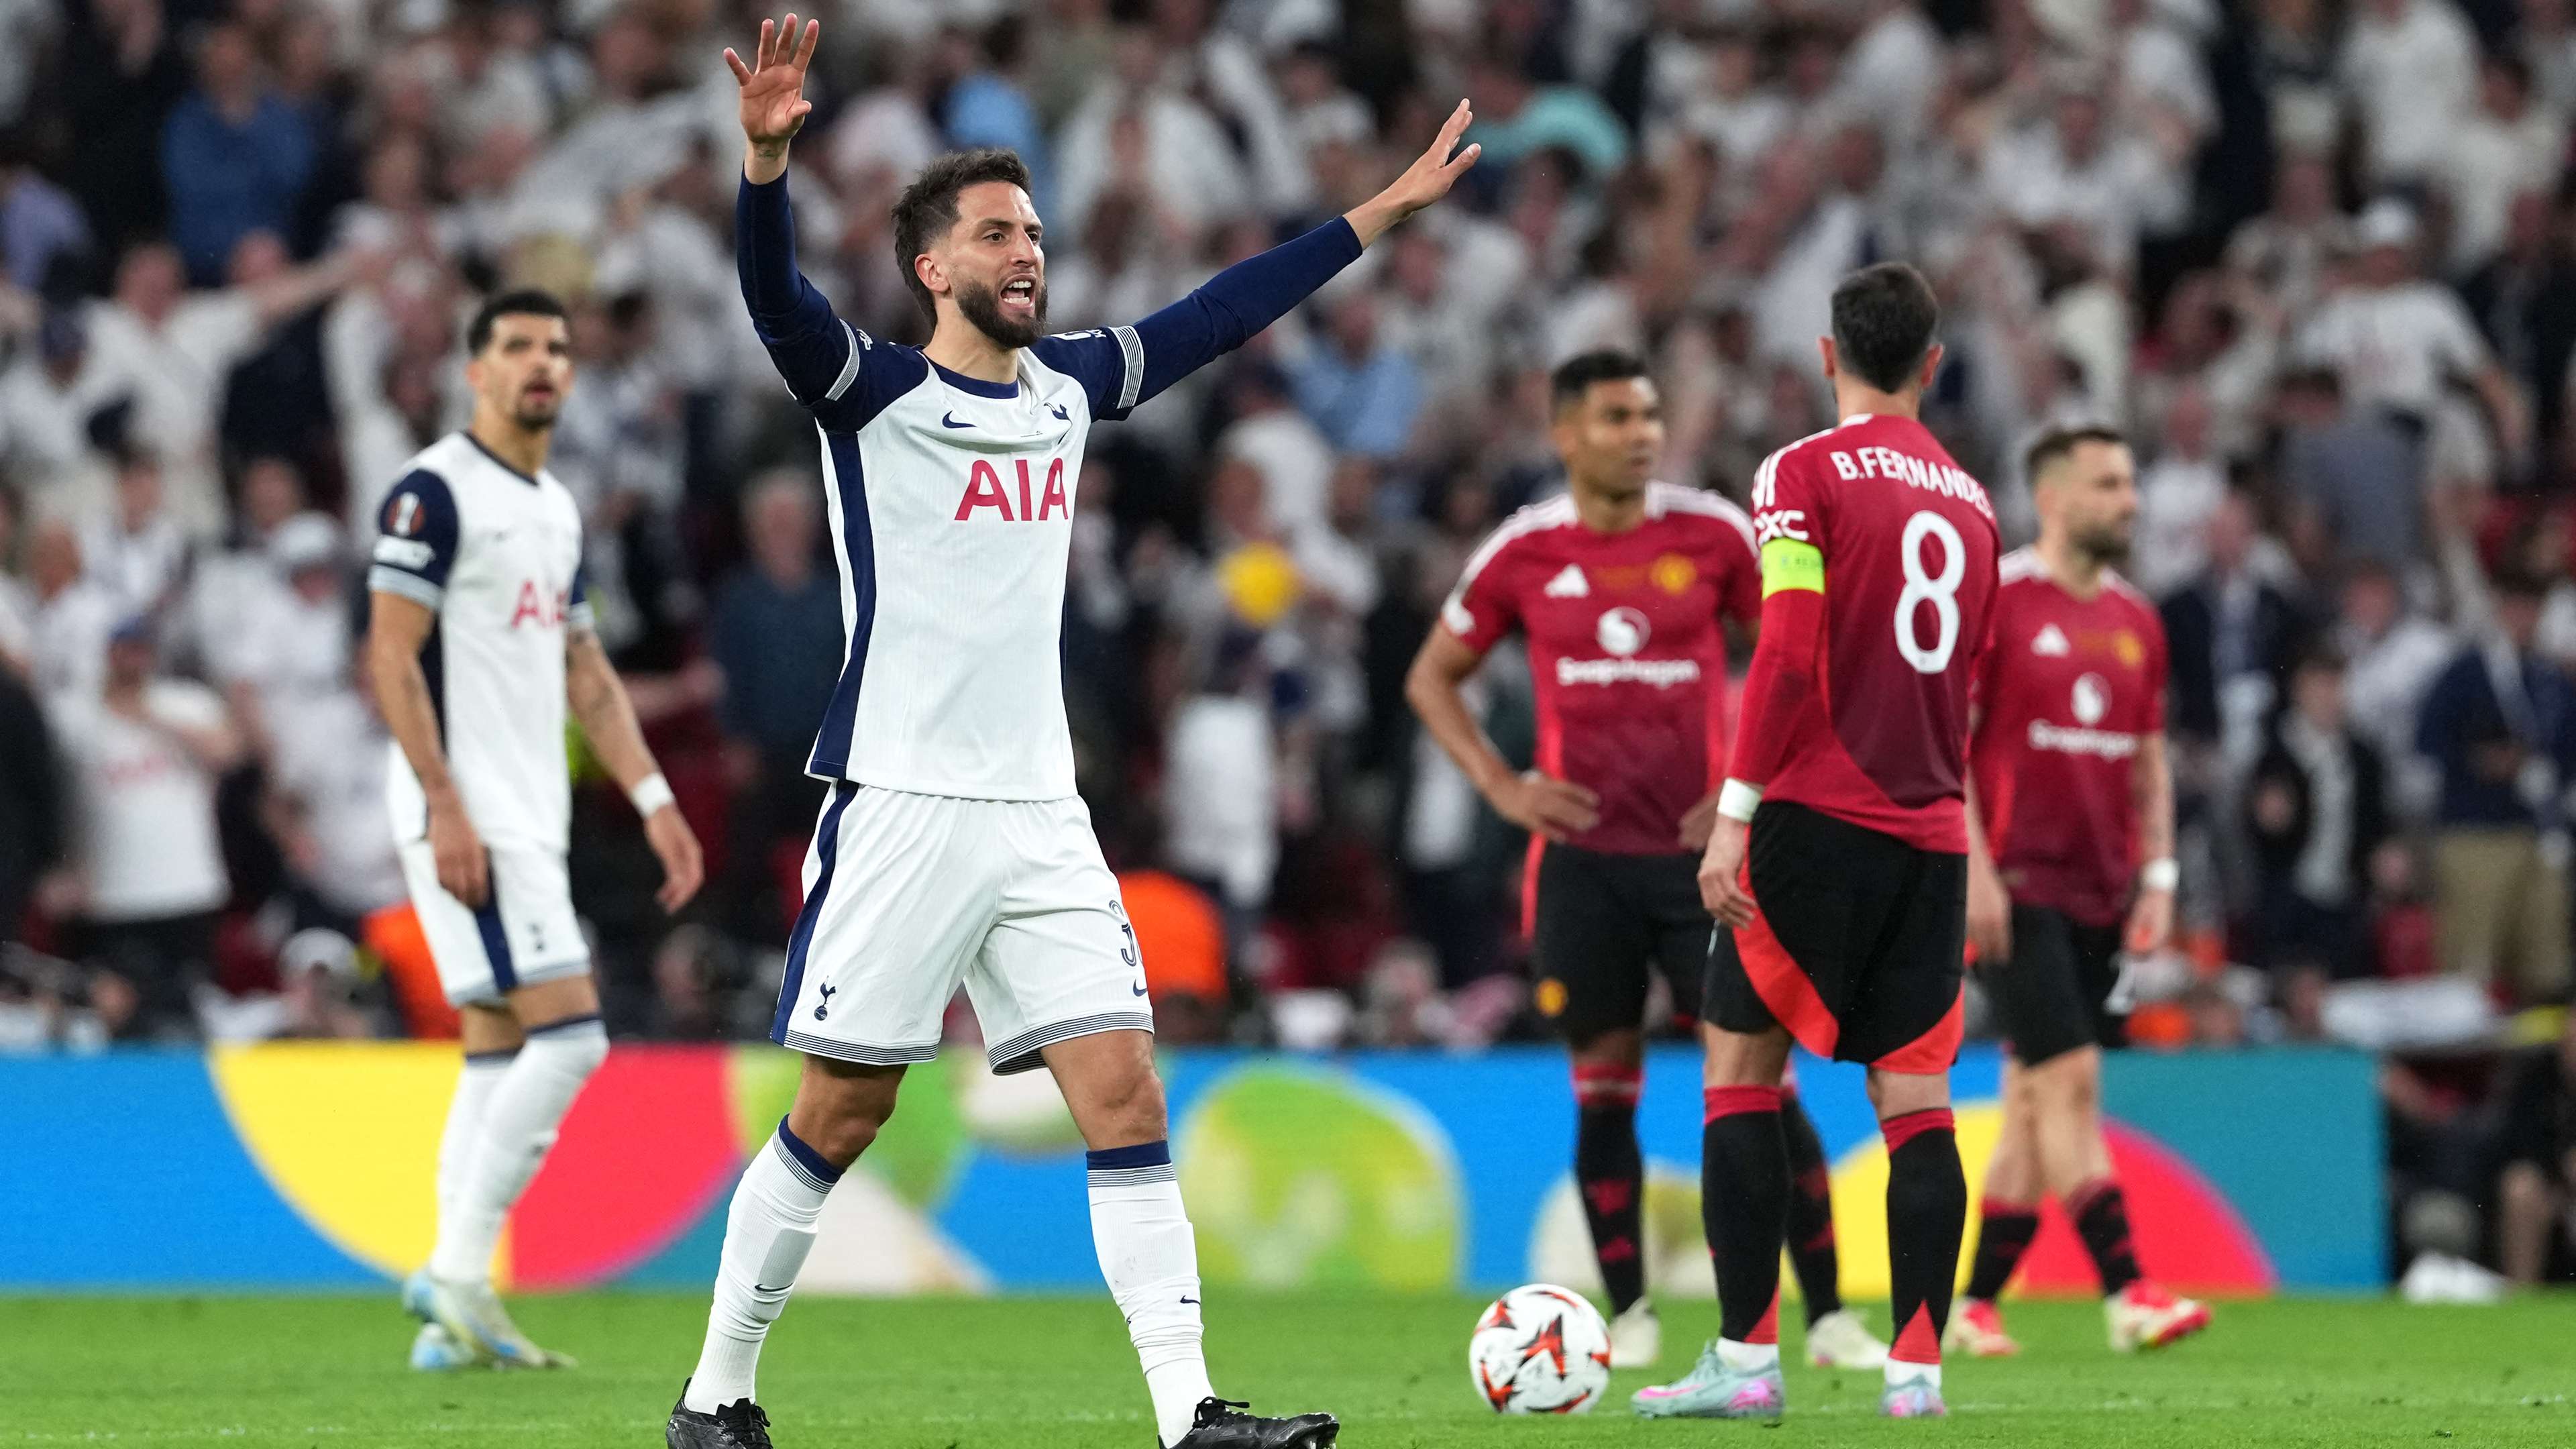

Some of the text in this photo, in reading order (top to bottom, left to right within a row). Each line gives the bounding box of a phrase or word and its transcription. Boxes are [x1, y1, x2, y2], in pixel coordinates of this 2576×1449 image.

[955, 458, 1069, 521] AIA
[1829, 446, 1994, 519] B.FERNANDE
[1894, 510, 1966, 674] 8
